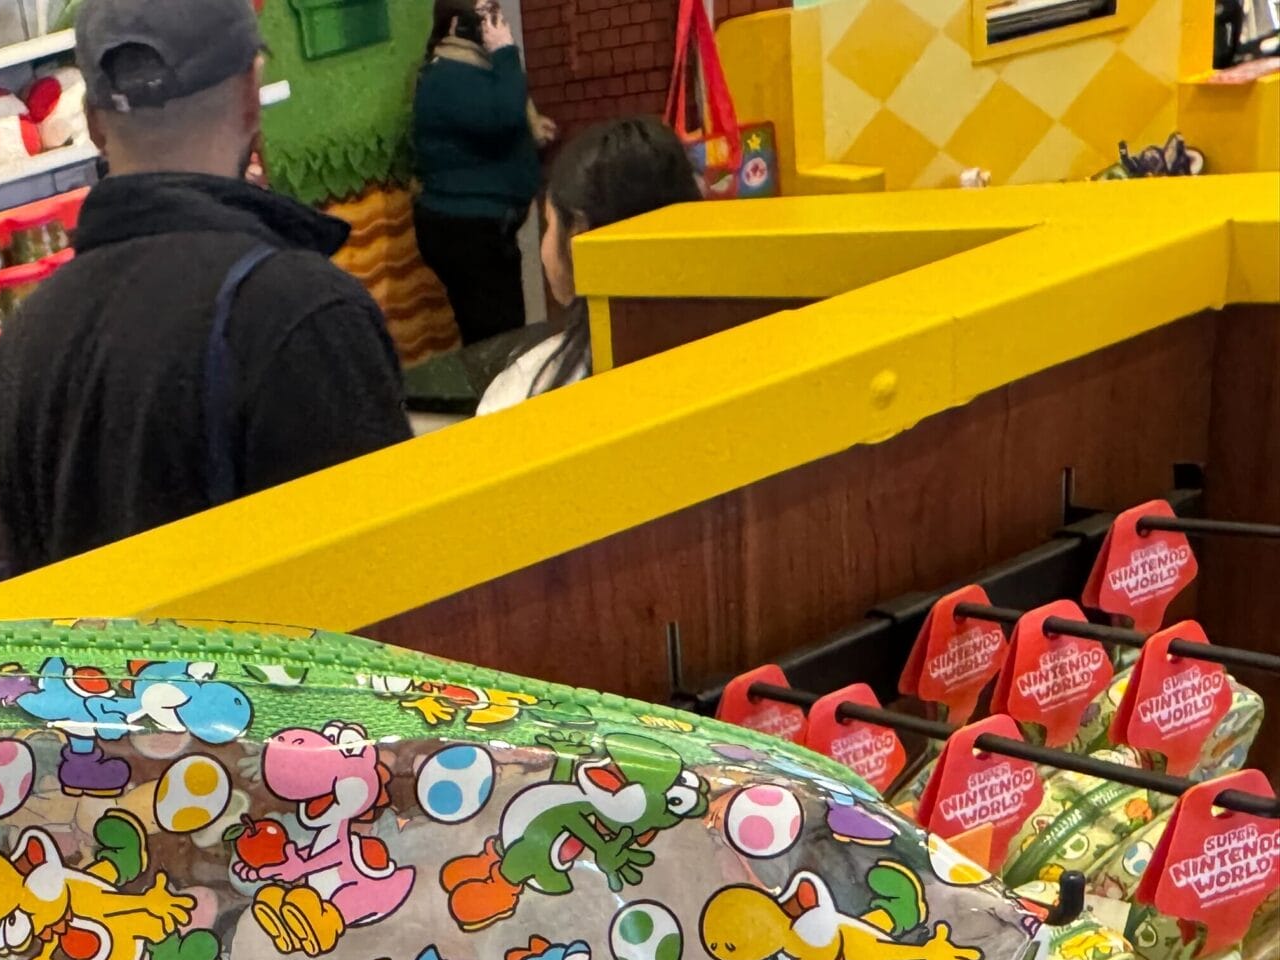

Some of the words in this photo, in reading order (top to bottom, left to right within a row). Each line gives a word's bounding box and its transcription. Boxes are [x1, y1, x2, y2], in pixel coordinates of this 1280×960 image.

[1110, 546, 1189, 590] NINTENDO
[1124, 565, 1178, 598] WORLD
[1018, 648, 1103, 695] NINTENDO
[1035, 670, 1093, 705] WORLD
[1138, 671, 1224, 722] NINTENDO
[1155, 695, 1214, 732] WORLD
[940, 767, 1035, 820] NINTENDO
[959, 791, 1023, 829] WORLD
[1204, 823, 1258, 855] SUPER
[1192, 856, 1272, 898] WORLD
